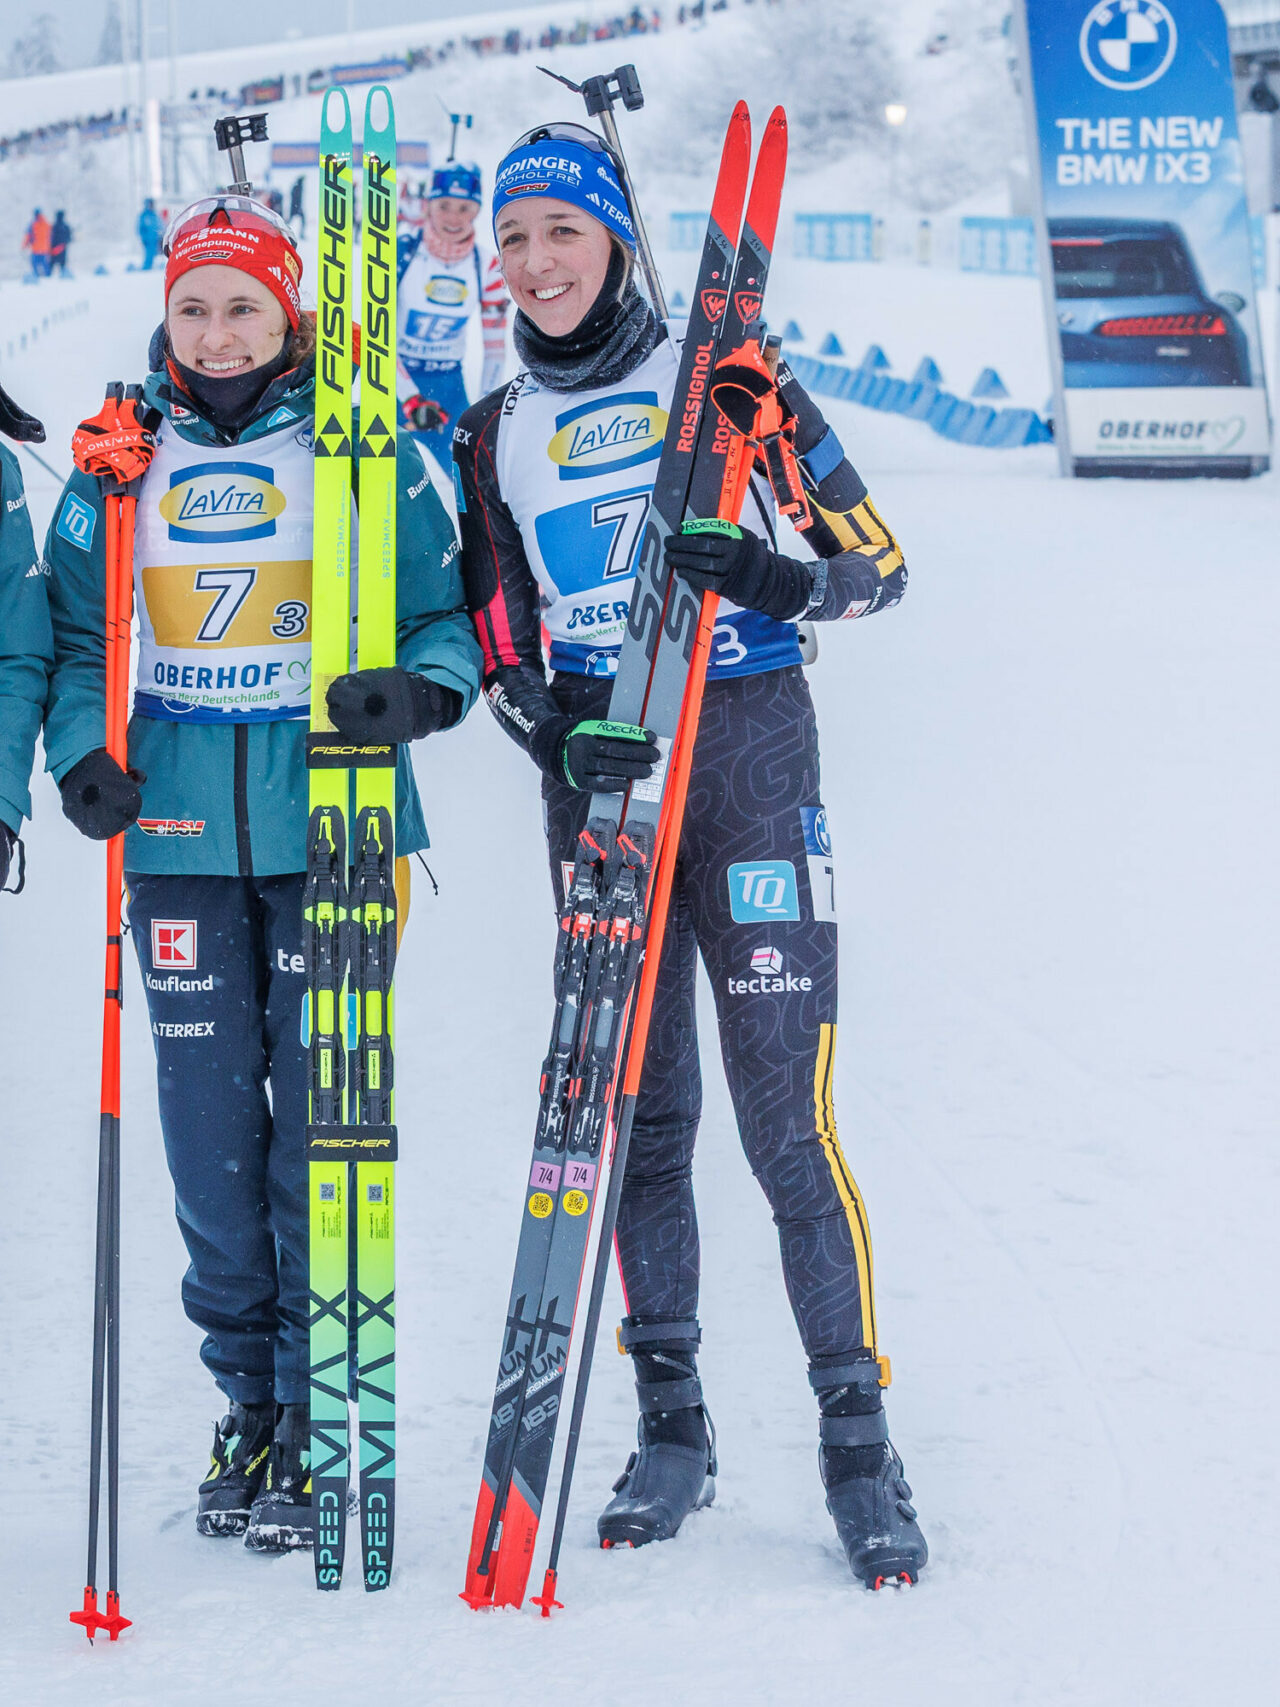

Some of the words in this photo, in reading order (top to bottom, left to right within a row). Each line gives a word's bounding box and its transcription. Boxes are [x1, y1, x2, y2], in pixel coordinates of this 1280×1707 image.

[1056, 117, 1131, 150] THE
[1139, 116, 1223, 149] NEW
[1057, 154, 1149, 187] BMW
[1156, 152, 1211, 184] iX3
[175, 240, 255, 260] Wärmepumpen
[177, 228, 260, 249] VIESSMANN
[322, 153, 347, 395] FISCHER
[367, 153, 391, 395] FISCHER
[415, 315, 453, 338] 15
[677, 339, 714, 453] ROSSIGNOL
[1100, 421, 1209, 438] OBERHOF
[592, 493, 650, 578] 7
[194, 568, 258, 642] 7
[270, 600, 308, 639] 3
[154, 661, 283, 690] OBERHOF
[178, 691, 200, 704] Herz
[202, 689, 280, 705] Deutschlands
[497, 692, 536, 734] Kaufland
[310, 745, 392, 755] FISCHER
[166, 820, 205, 837] DSV
[737, 867, 790, 914] TQ
[146, 974, 214, 993] Kaufland
[728, 972, 813, 995] tectake
[158, 1022, 215, 1038] TERREX
[310, 1138, 391, 1149] FISCHER
[538, 1167, 554, 1185] 7/4
[572, 1166, 588, 1184] 7/4
[521, 1394, 559, 1432] 183
[319, 1491, 340, 1585] SPEED
[367, 1492, 387, 1586] SPEED
